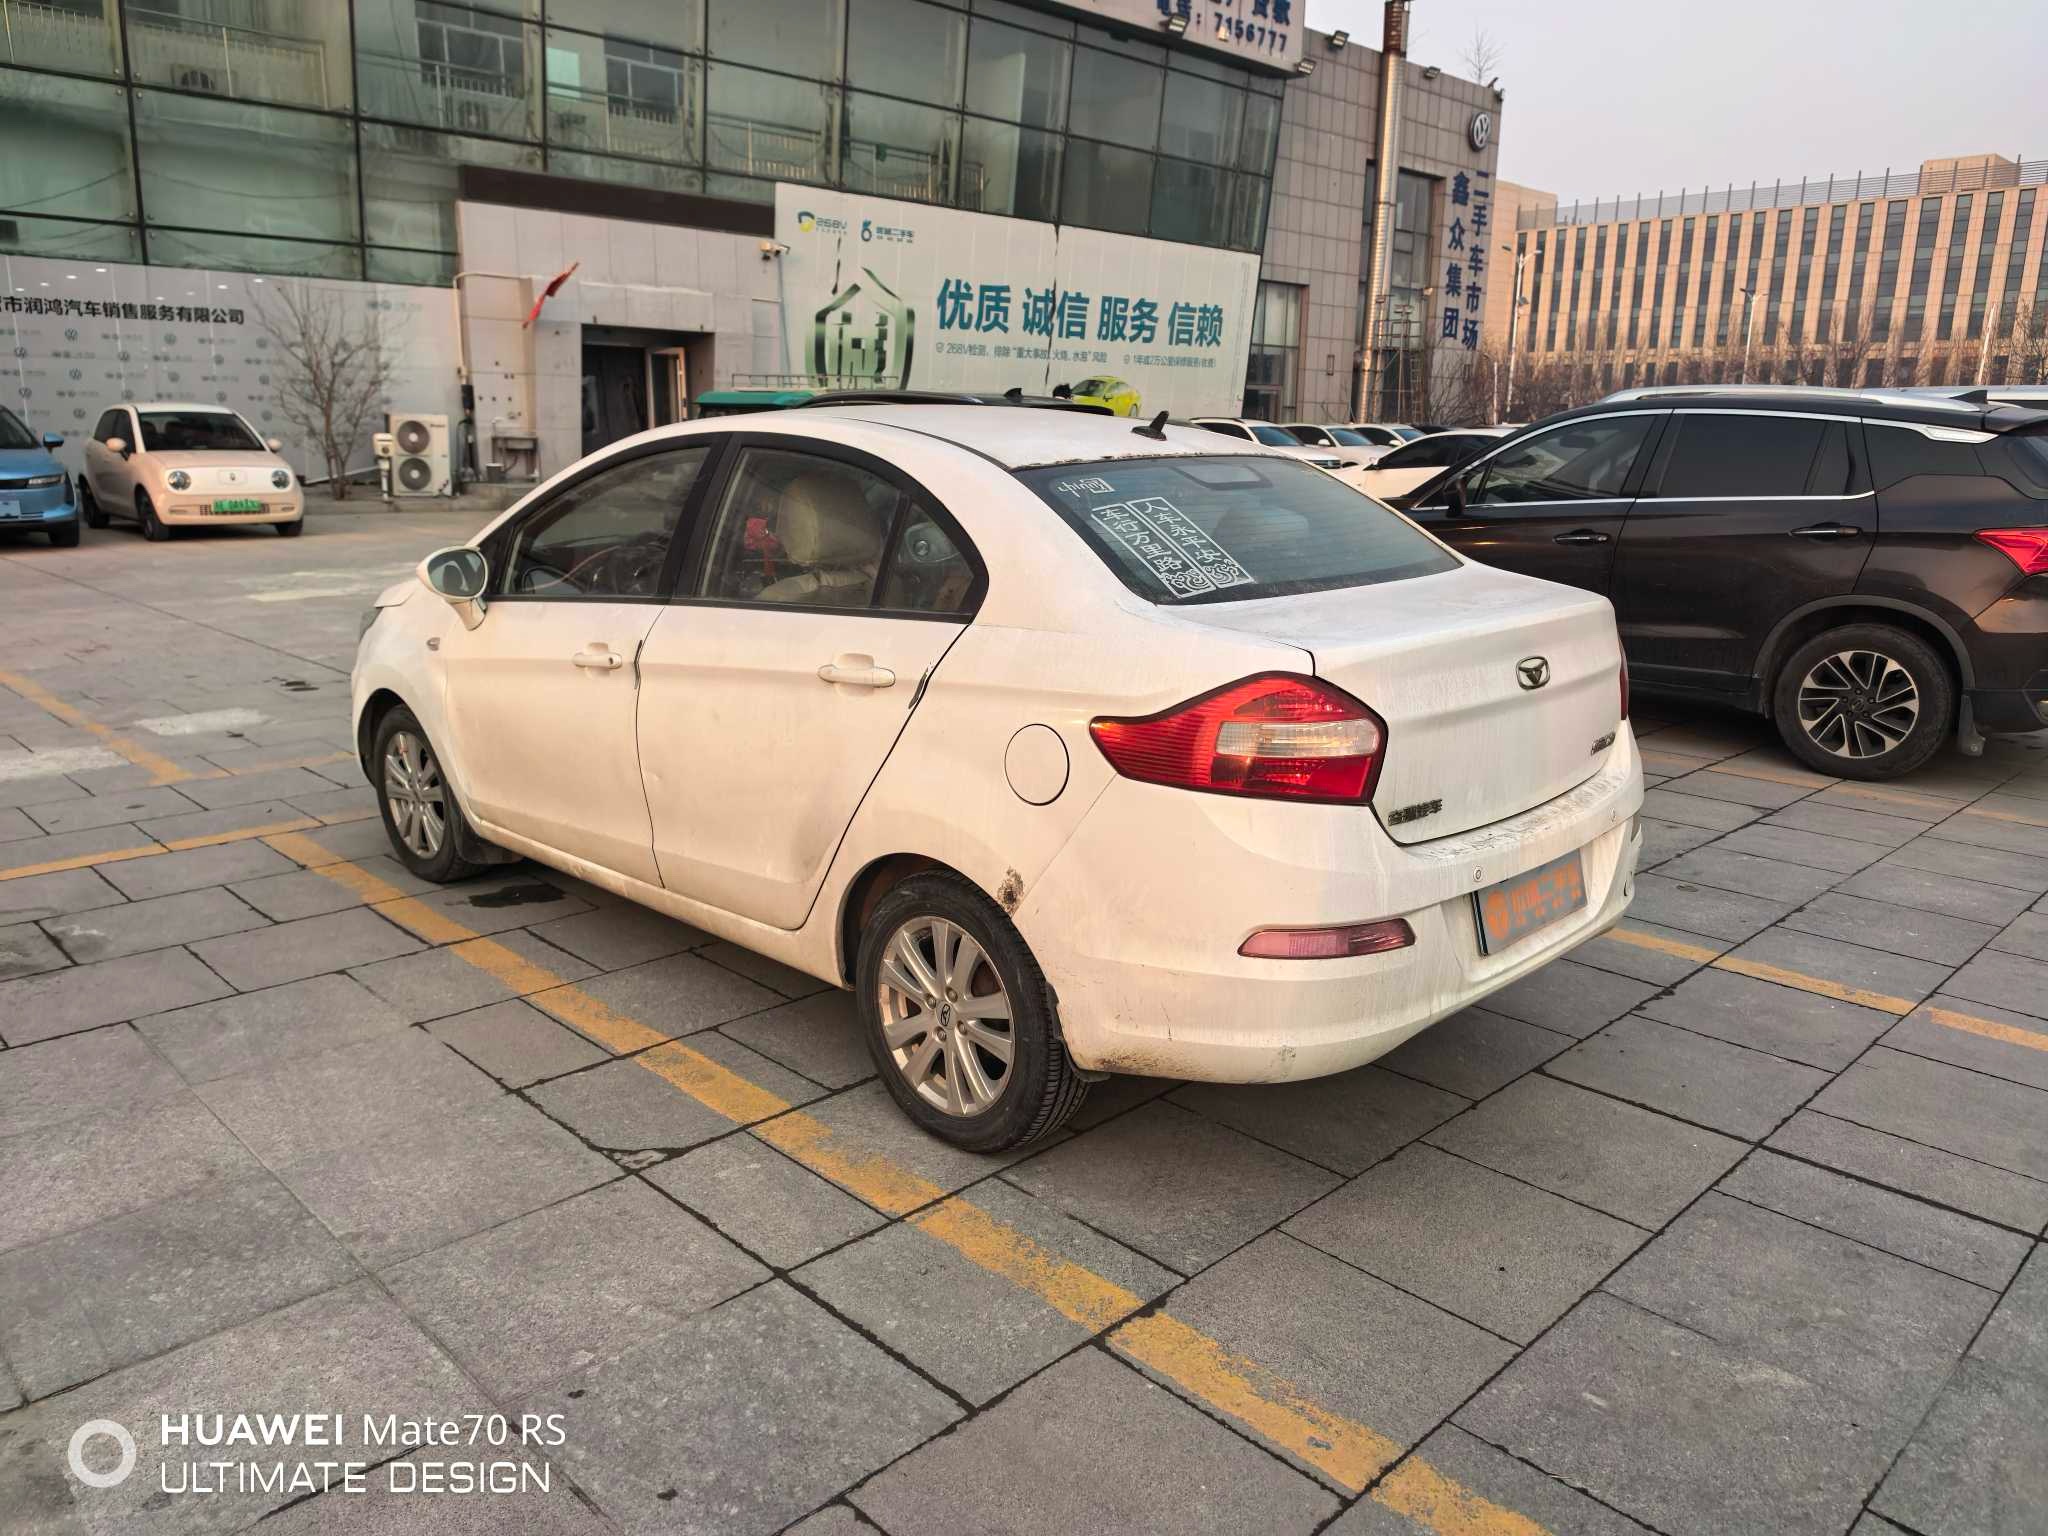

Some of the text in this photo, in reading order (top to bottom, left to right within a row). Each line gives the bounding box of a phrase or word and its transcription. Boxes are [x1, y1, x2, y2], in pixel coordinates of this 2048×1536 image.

[1443, 171, 1470, 340] 鑫众集团
[1461, 170, 1489, 350] 二手车市场
[0, 296, 245, 325] 市润鸿汽车销售服务有限公司
[936, 278, 1224, 348] 优质 诚信 服务 信赖
[1145, 502, 1222, 564] 人车永平安
